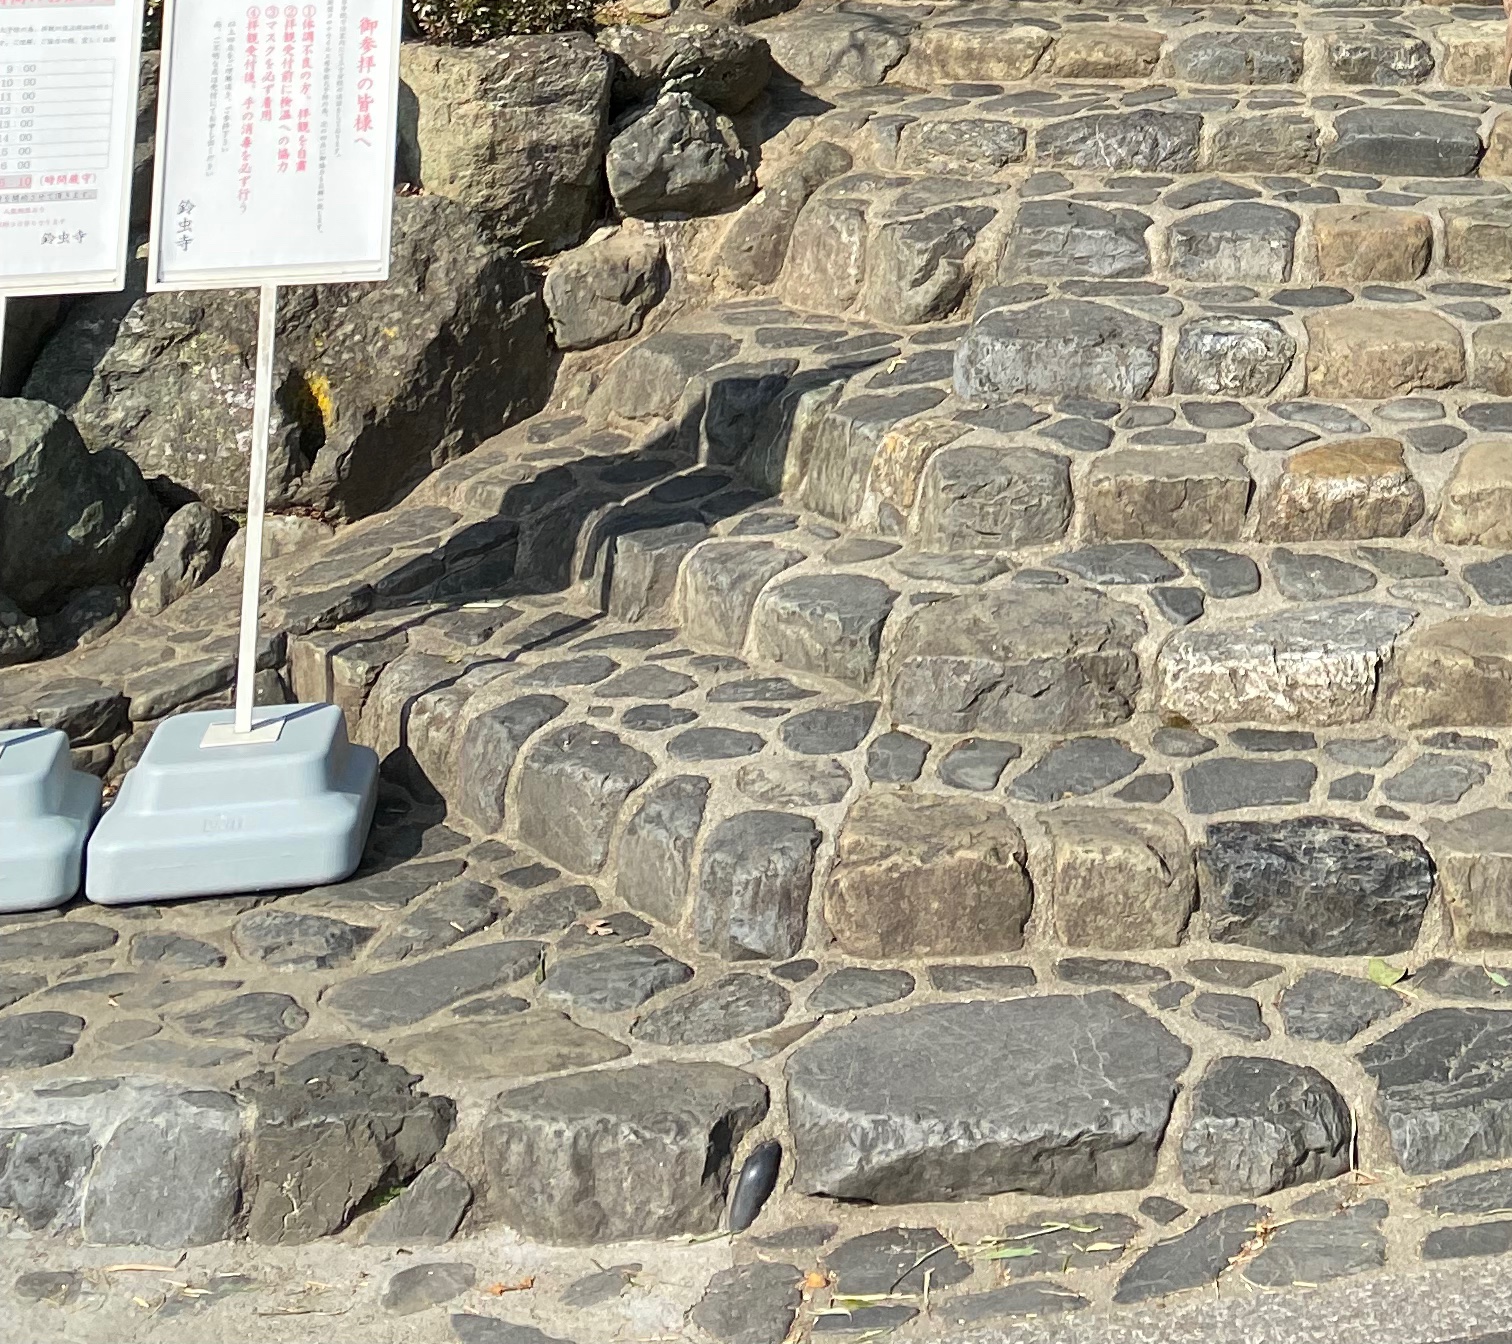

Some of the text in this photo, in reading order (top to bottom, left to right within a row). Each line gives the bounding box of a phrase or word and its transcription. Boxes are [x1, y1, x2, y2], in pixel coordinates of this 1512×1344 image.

[353, 16, 379, 147] 御参拝の皆様へ
[40, 229, 87, 245] 鈴虫寺
[175, 199, 197, 252] 鈴虫寺
